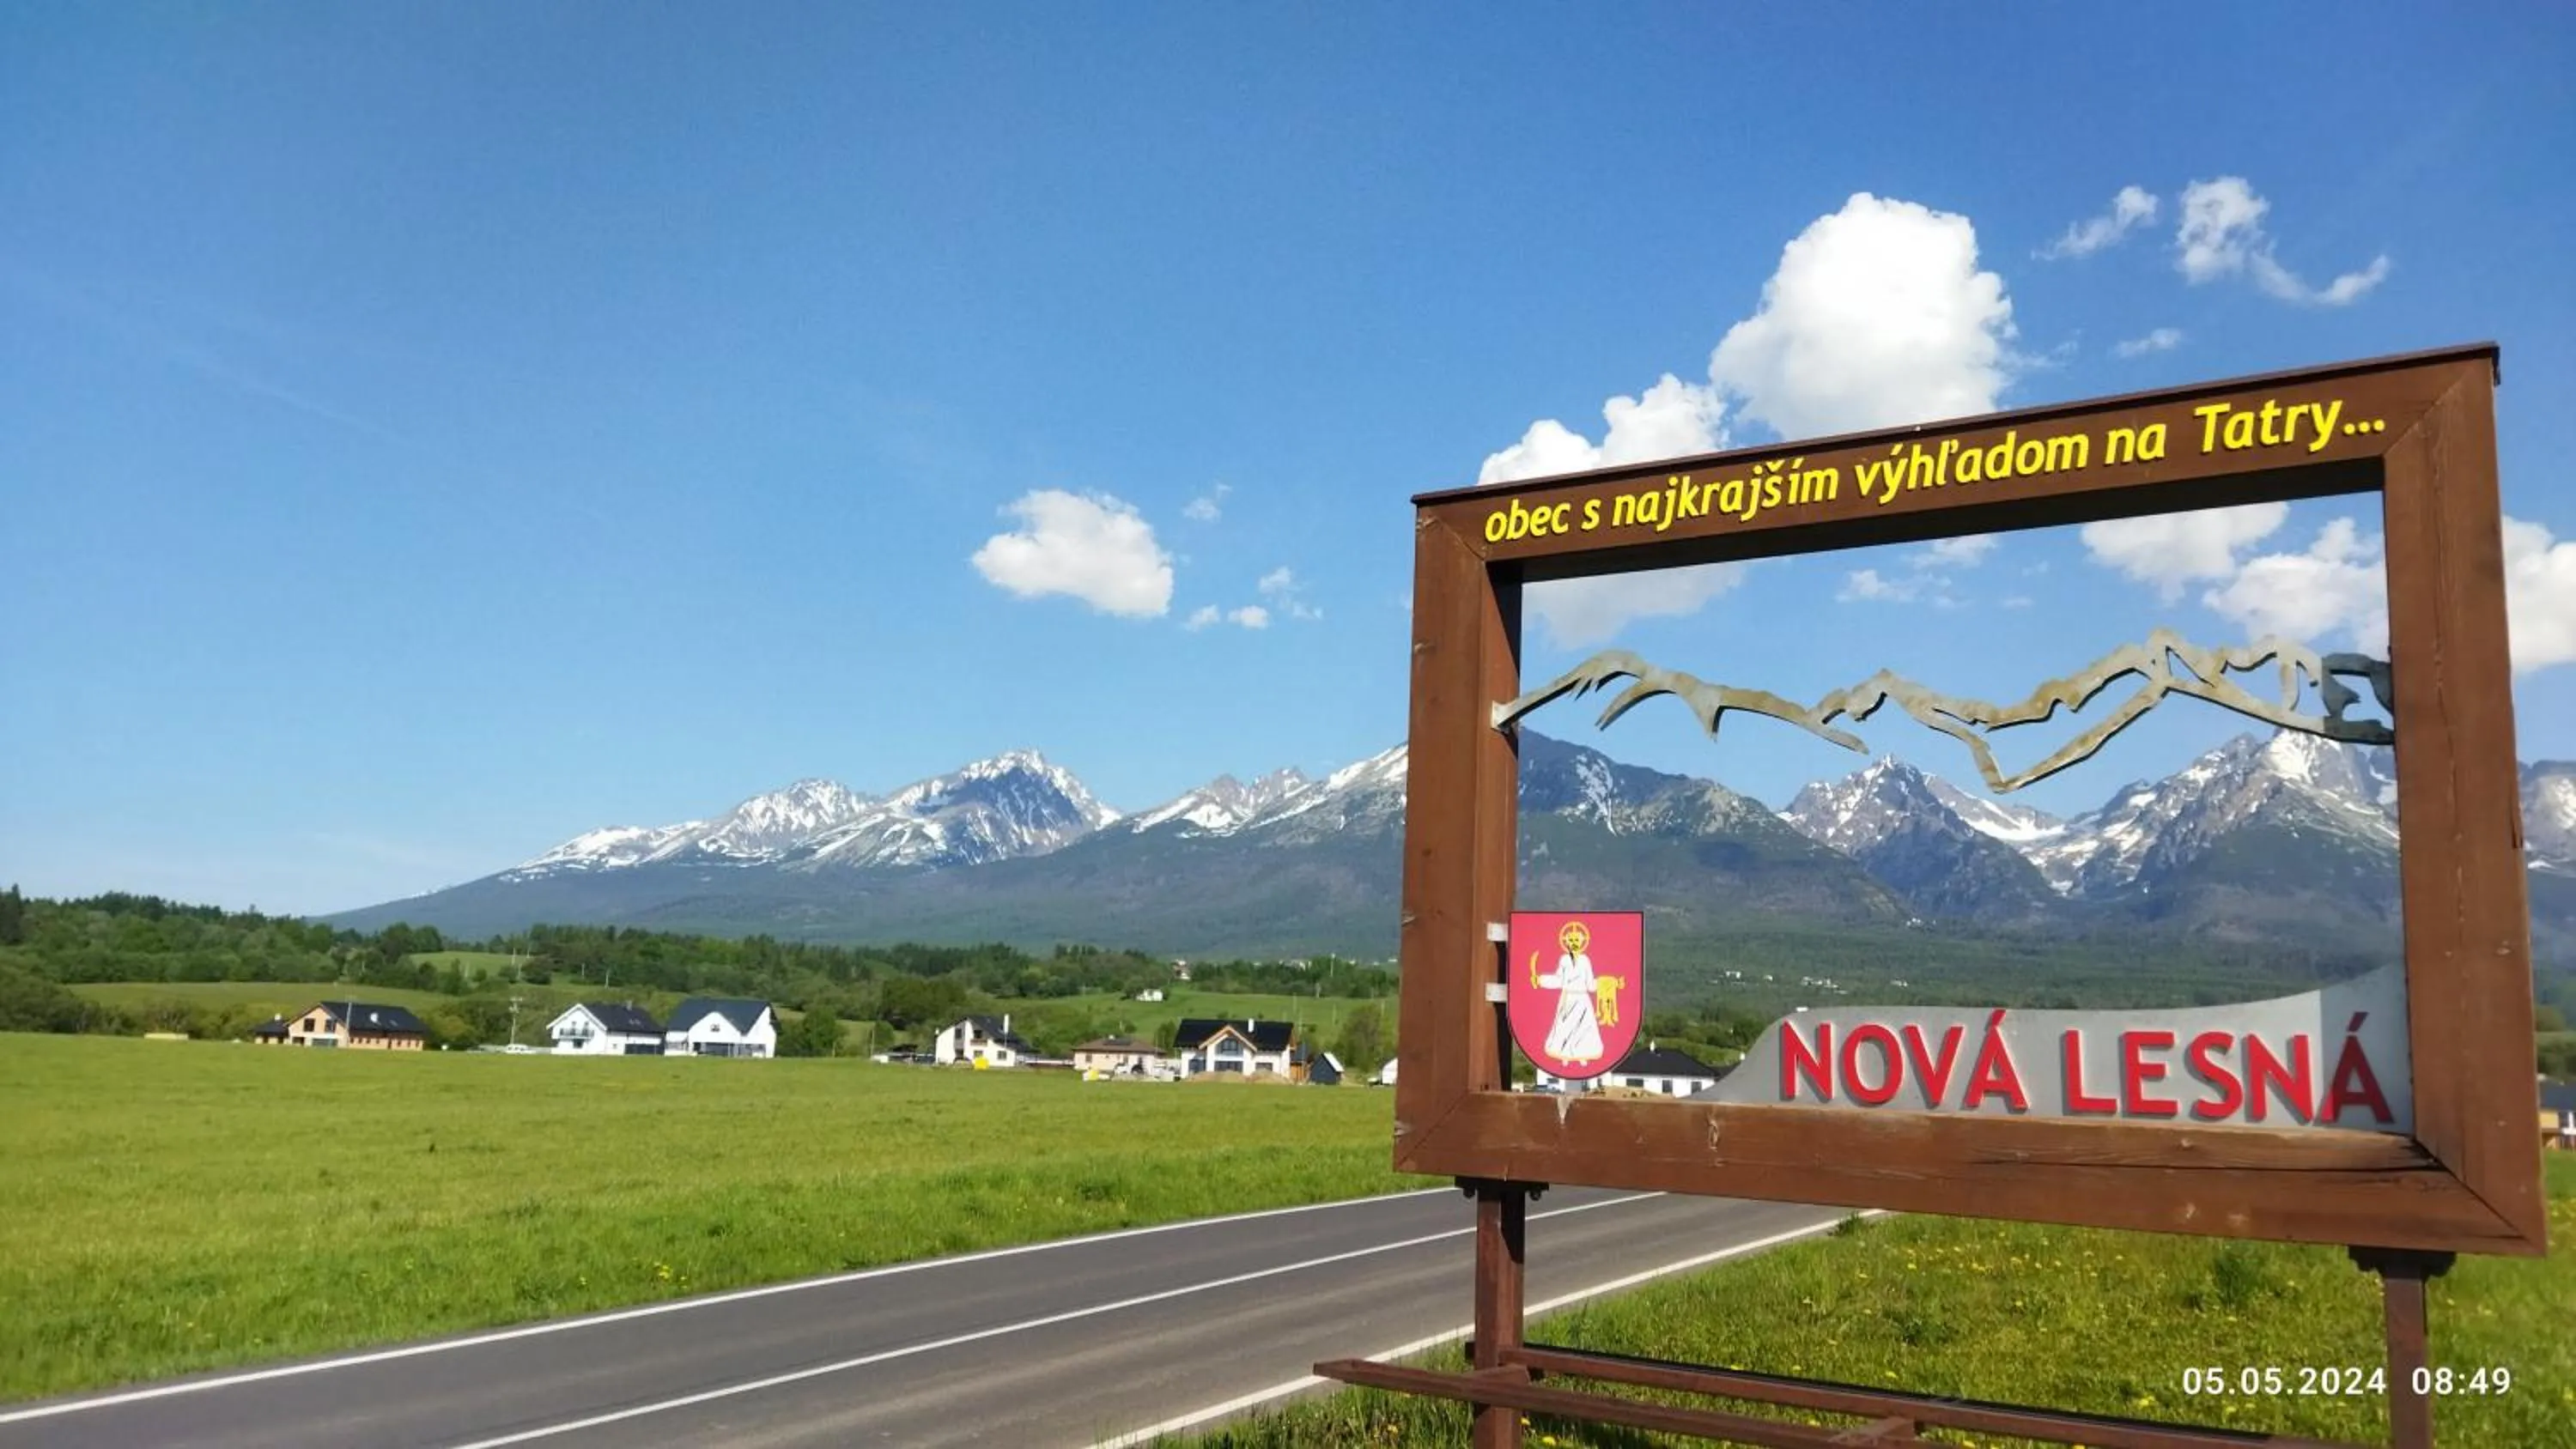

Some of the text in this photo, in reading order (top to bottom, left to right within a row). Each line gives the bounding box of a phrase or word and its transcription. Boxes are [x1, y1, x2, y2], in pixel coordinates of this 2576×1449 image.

[1485, 399, 2386, 543] obec s najkrajším výhľadom na Tatry...
[1780, 1009, 2394, 1125] NOVÁ LESNÁ
